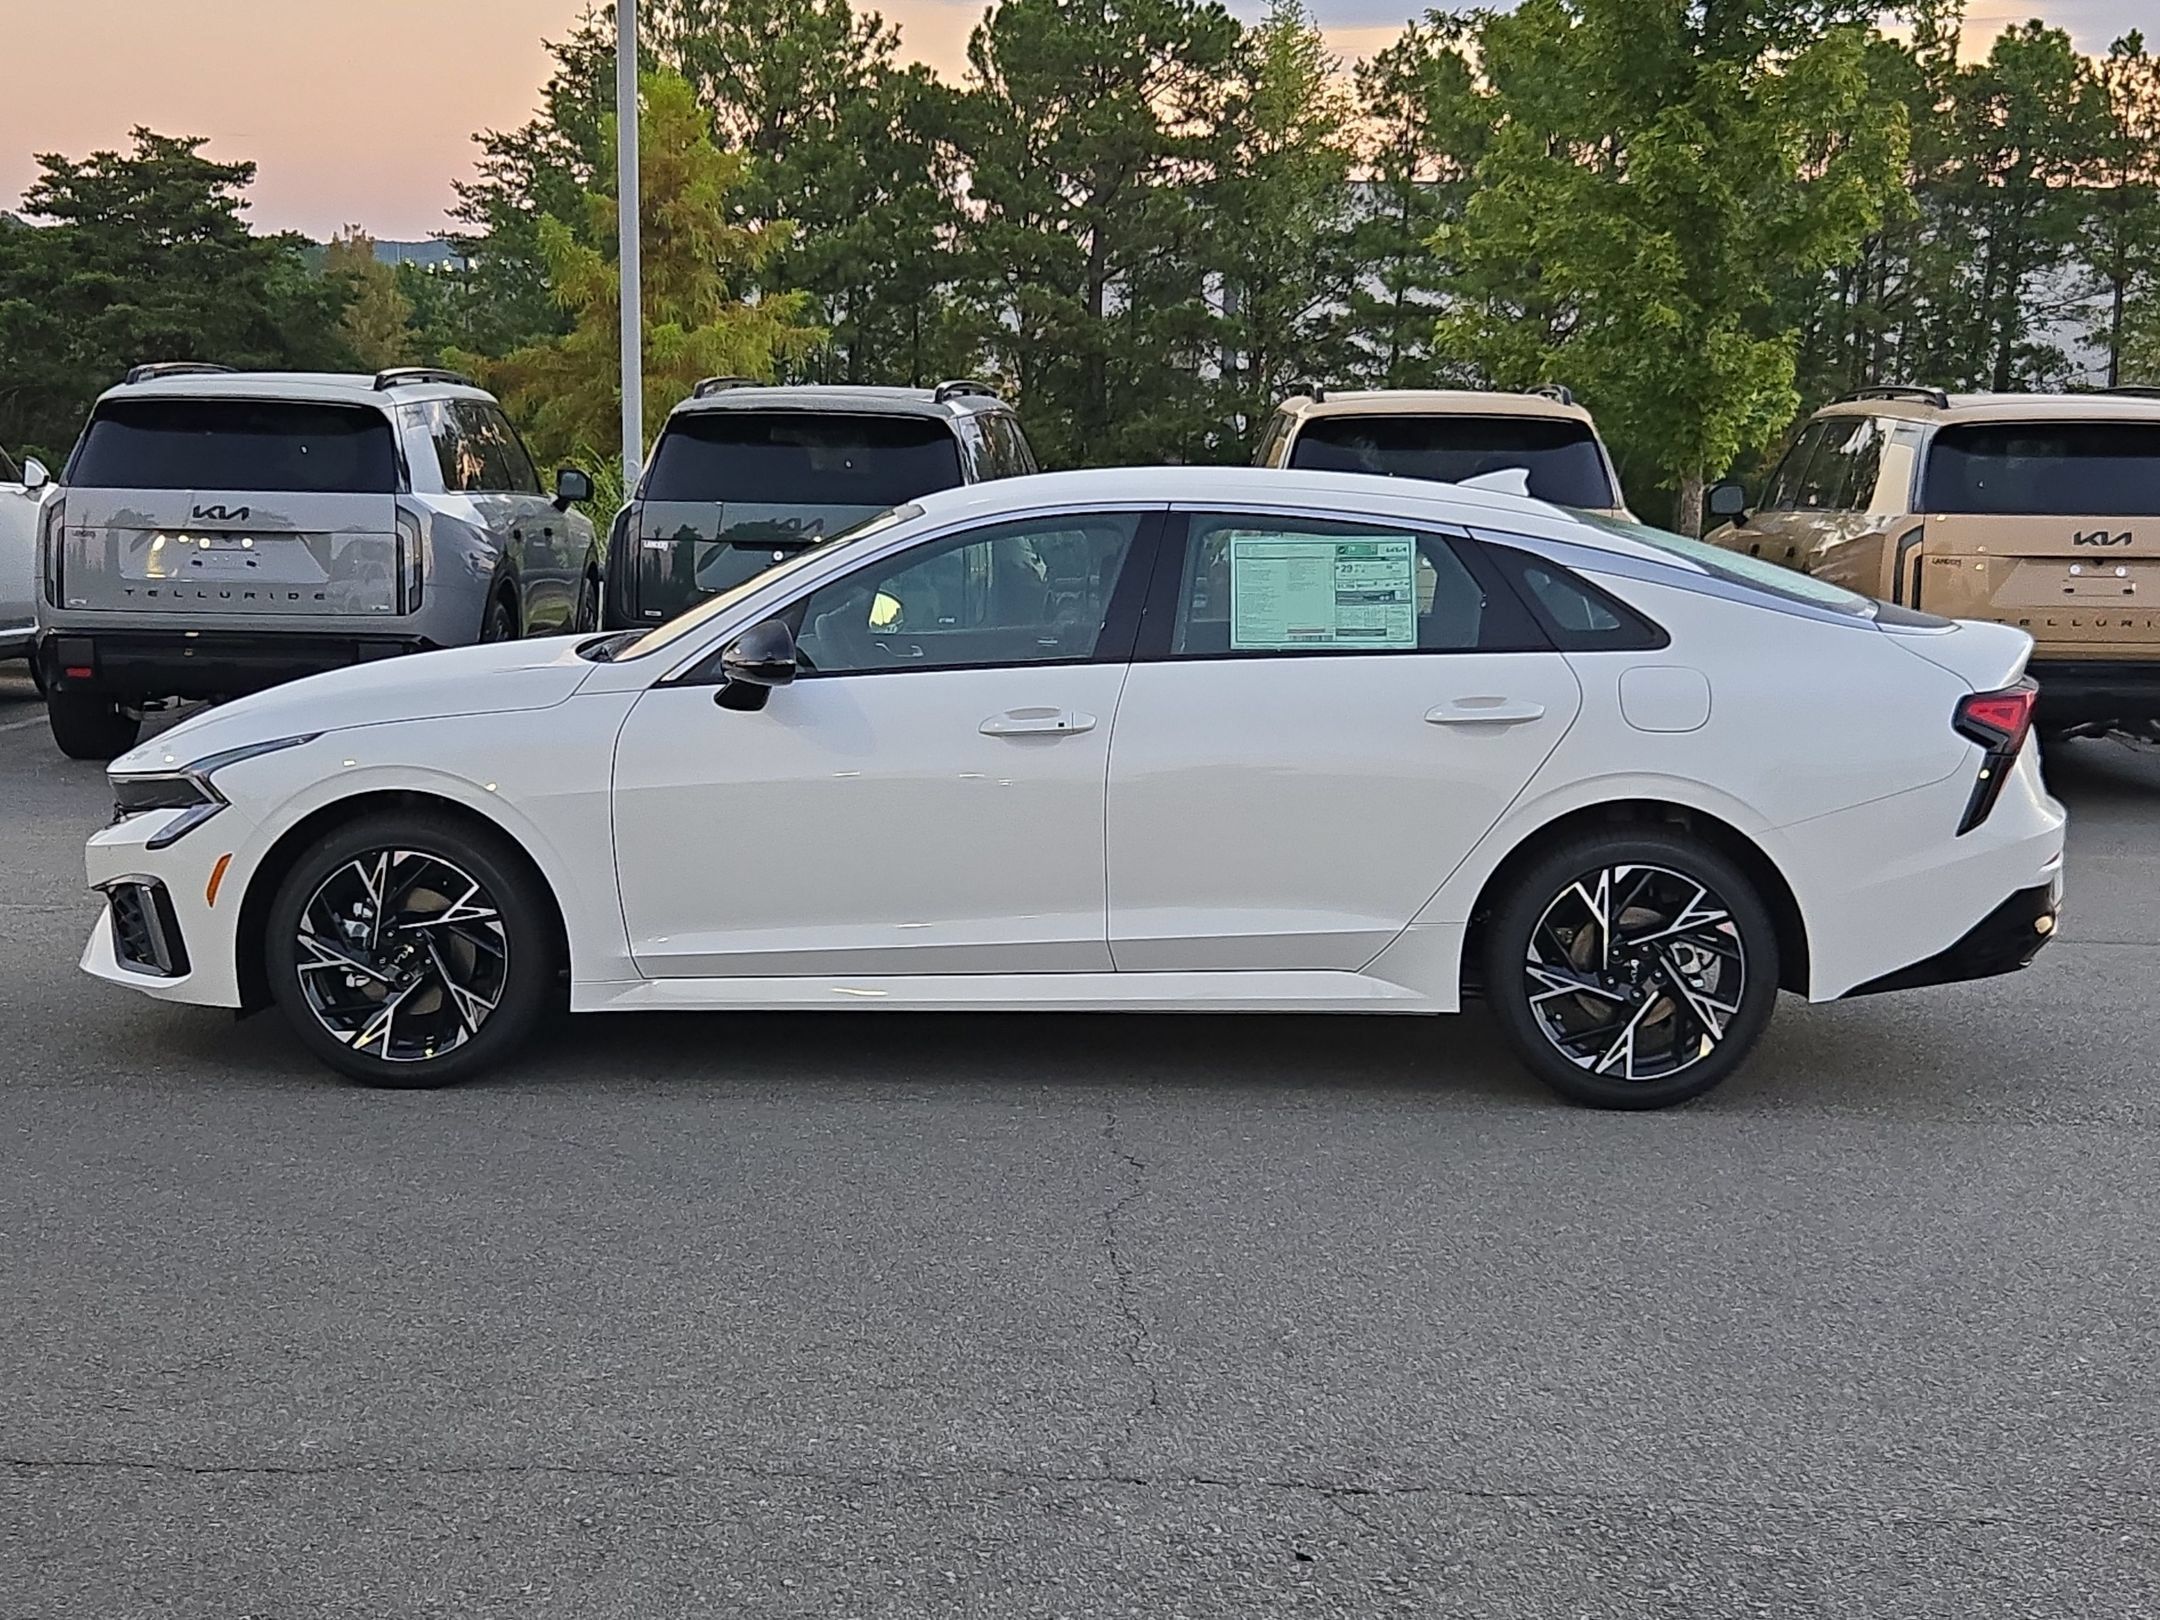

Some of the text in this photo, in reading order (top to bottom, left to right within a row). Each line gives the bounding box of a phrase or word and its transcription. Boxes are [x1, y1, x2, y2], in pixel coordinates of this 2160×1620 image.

[193, 505, 249, 521] KIA
[2073, 531, 2132, 546] KIA
[125, 589, 326, 601] TELLURIDE
